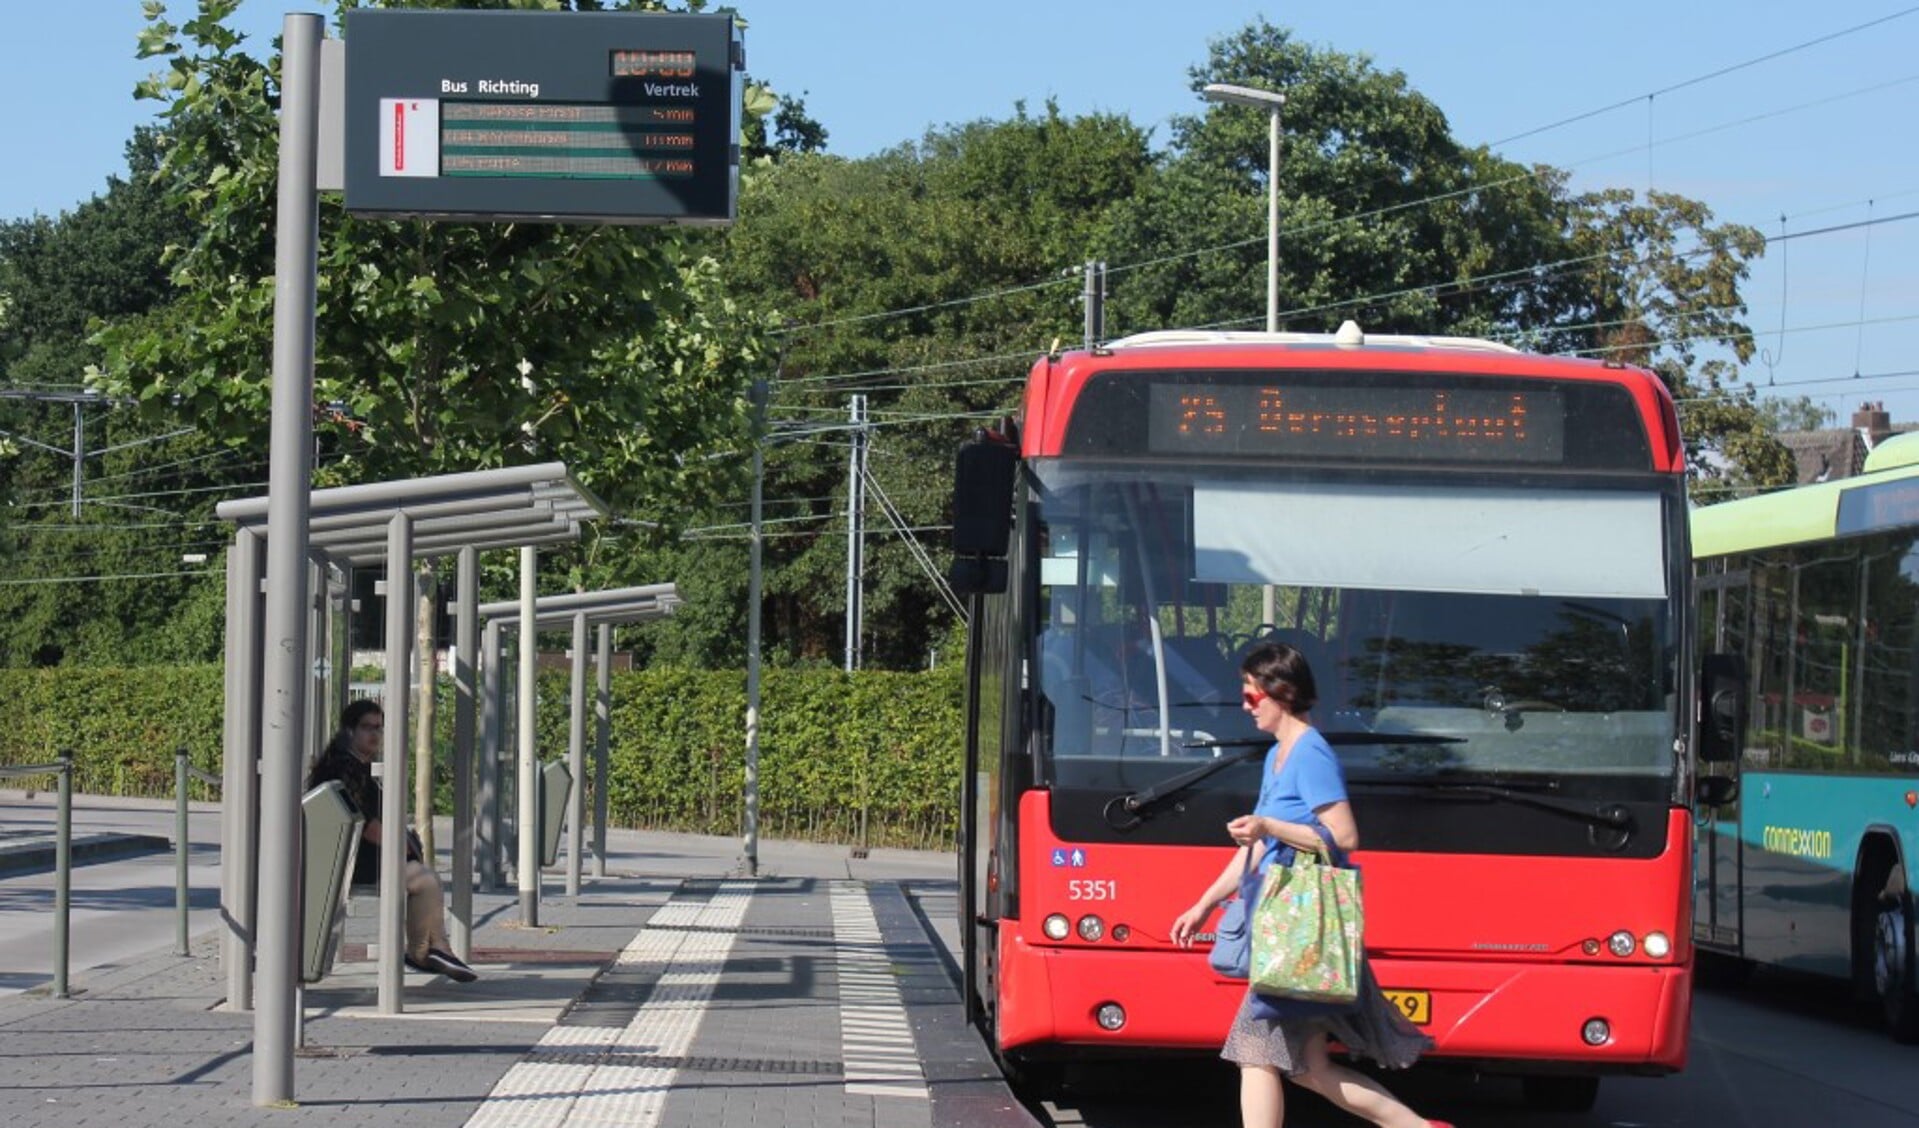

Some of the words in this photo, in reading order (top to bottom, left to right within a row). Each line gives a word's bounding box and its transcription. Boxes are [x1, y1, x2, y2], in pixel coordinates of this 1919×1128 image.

[441, 80, 468, 93] Bus
[478, 80, 540, 97] Richting
[644, 83, 699, 97] Vertrek
[1763, 826, 1831, 859] connexxion
[1069, 880, 1116, 900] 5351
